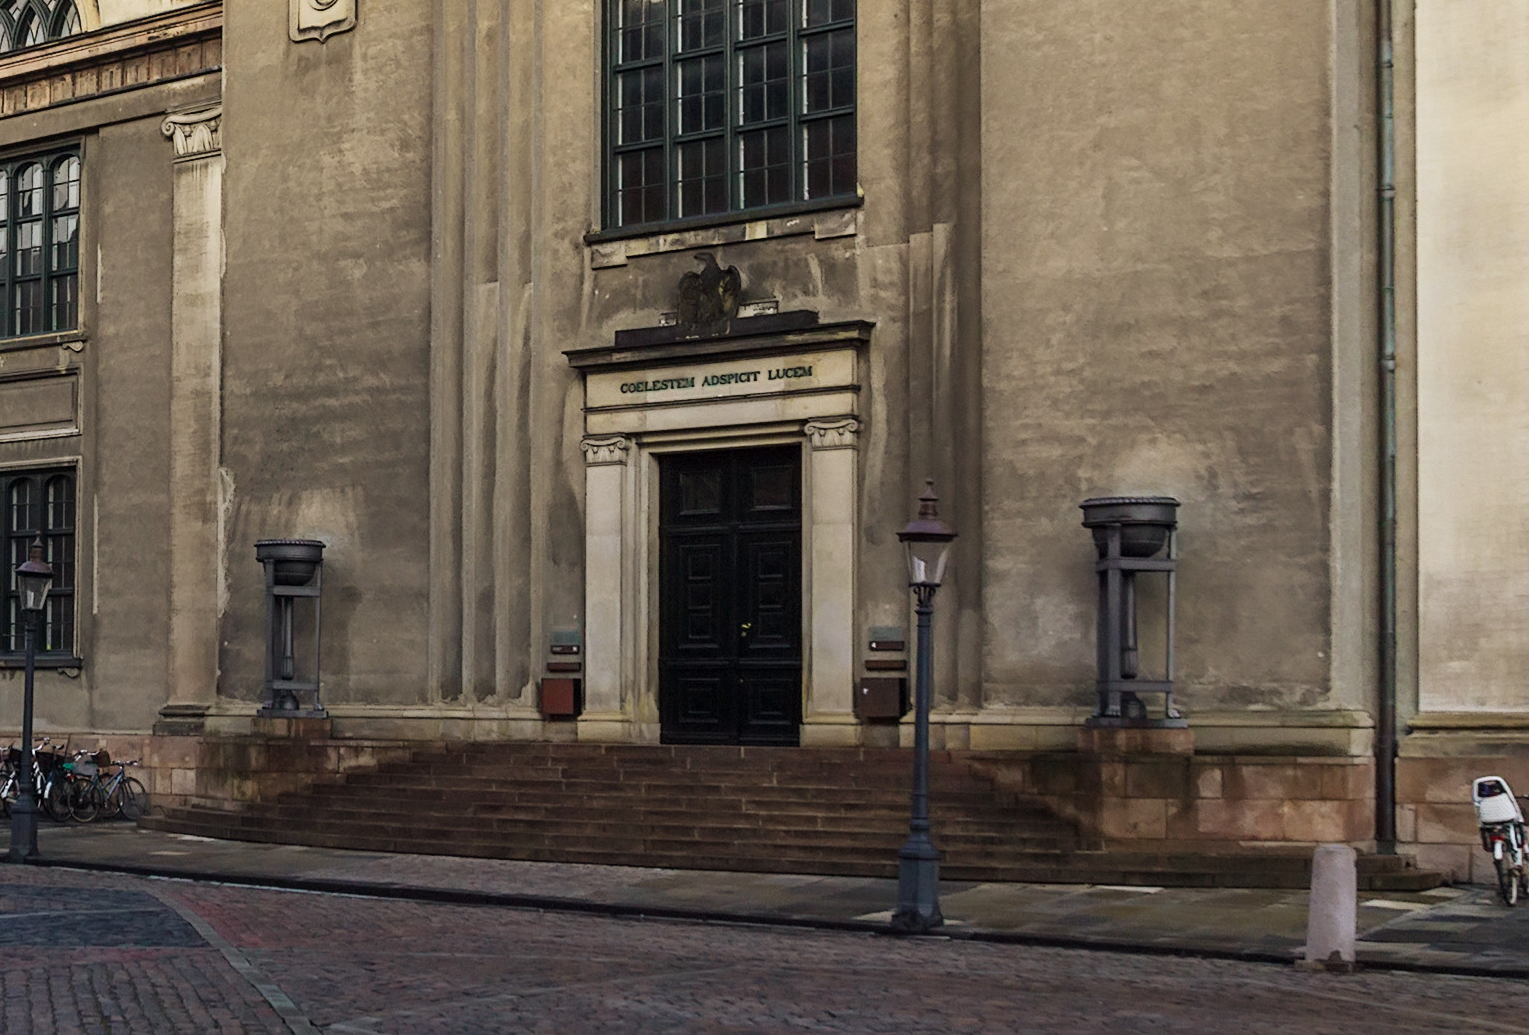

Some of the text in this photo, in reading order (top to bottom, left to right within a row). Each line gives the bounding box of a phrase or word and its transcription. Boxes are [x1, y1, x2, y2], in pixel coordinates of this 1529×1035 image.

[620, 366, 813, 394] COELESTEM ADSPICIT LUCEM
